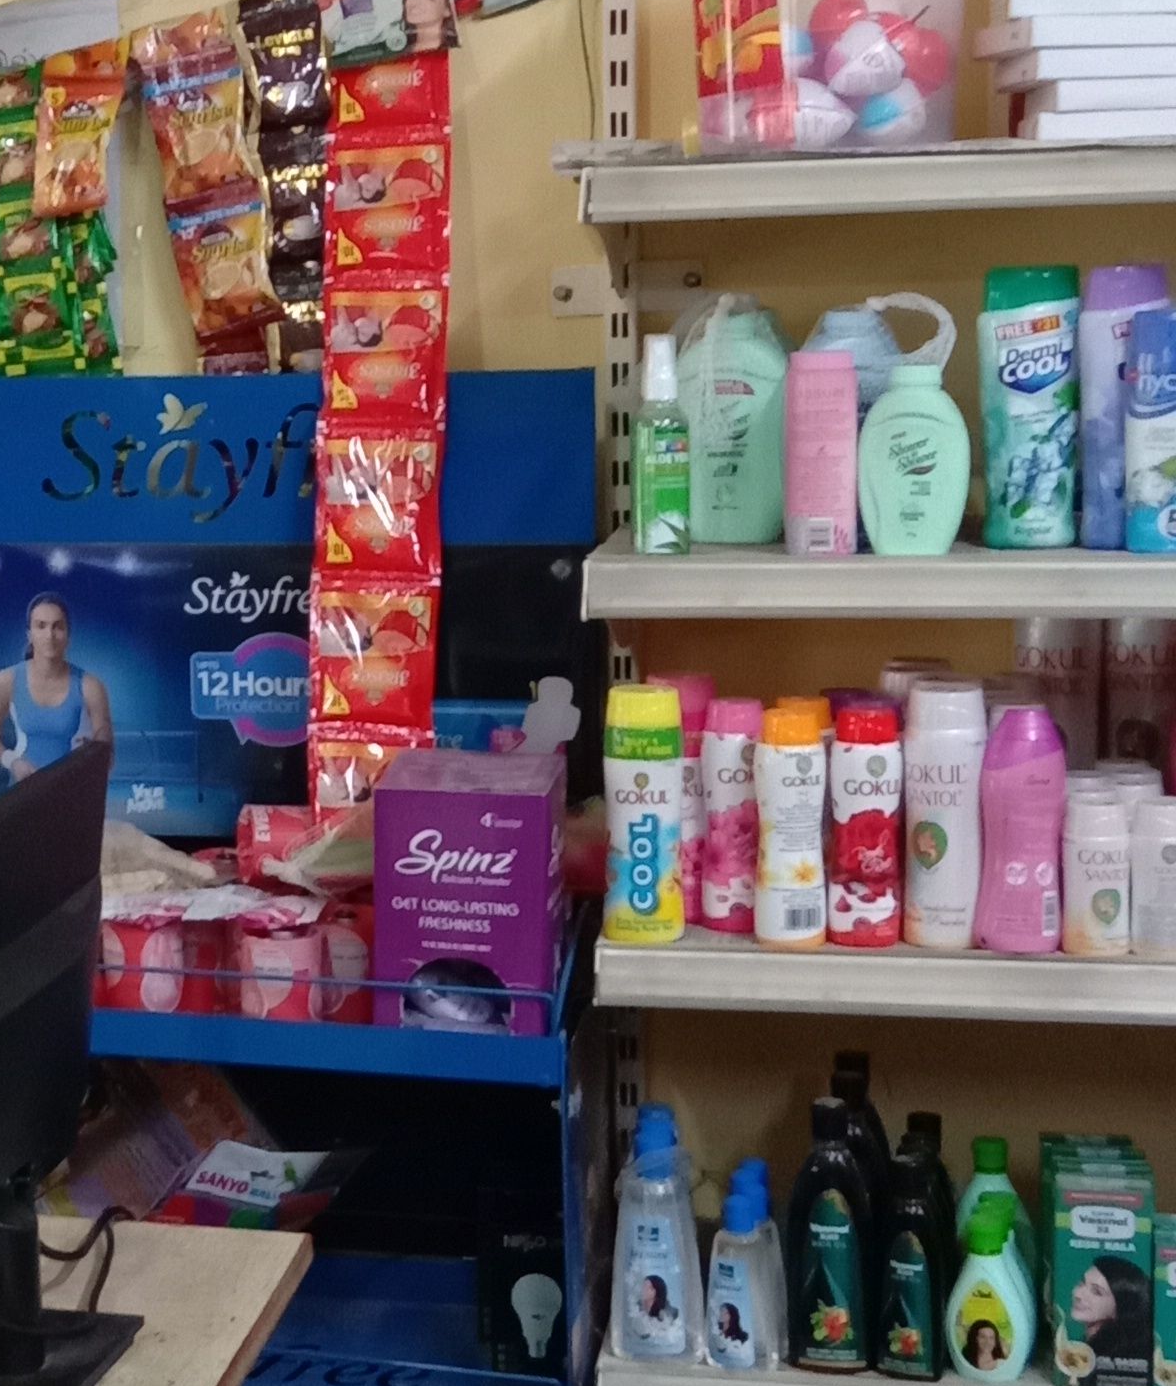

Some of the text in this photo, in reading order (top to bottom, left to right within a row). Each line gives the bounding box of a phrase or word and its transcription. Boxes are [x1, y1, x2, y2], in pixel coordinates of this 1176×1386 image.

[1006, 338, 1064, 363] Dermi
[1002, 354, 1070, 384] COOL
[41, 401, 318, 524] Stayf
[197, 671, 230, 697] 12
[843, 779, 903, 797] GOKU
[394, 829, 518, 884] Spinz
[630, 814, 658, 914] COOL
[391, 895, 520, 917] GET LONG-LASTING
[418, 915, 492, 933] FRESHNESS
[195, 1169, 249, 1194] SANYO
